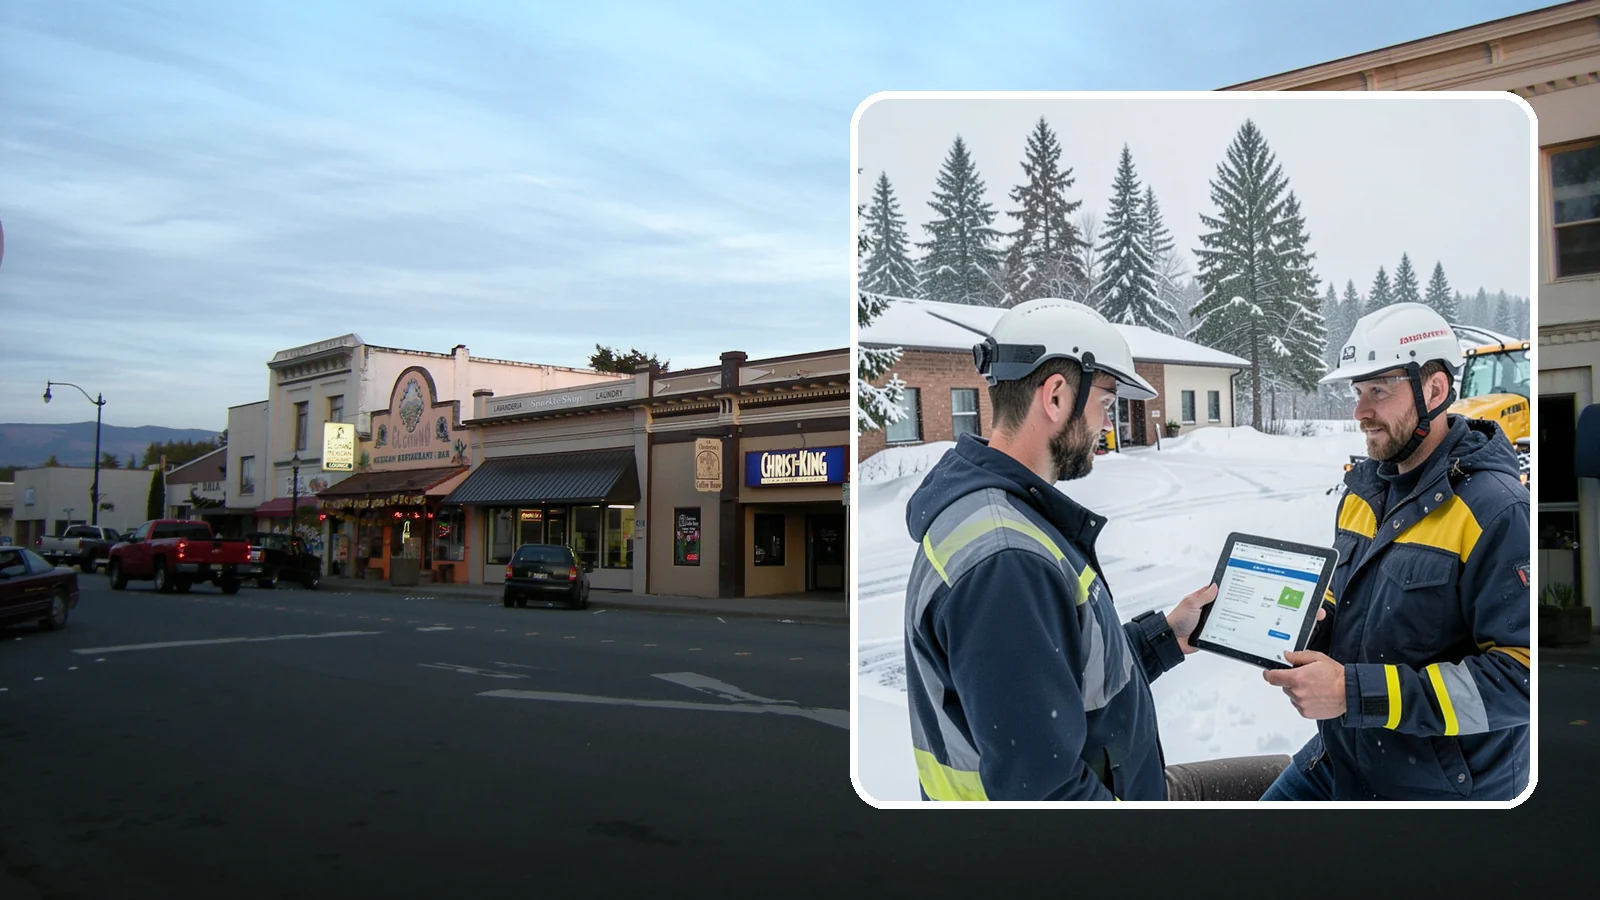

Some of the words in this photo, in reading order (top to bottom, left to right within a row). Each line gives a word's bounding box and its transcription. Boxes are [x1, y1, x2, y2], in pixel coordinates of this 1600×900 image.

[595, 389, 624, 400] LAUNDRY
[493, 402, 522, 413] LAVANDERIA
[531, 398, 560, 409] Sparkle
[562, 394, 582, 405] Shop
[373, 455, 396, 464] MEXICAN
[397, 452, 433, 462] RESTAURANT
[438, 450, 450, 459] BAR
[799, 450, 827, 476] KING
[697, 481, 709, 489] Coffee
[710, 481, 722, 489] House
